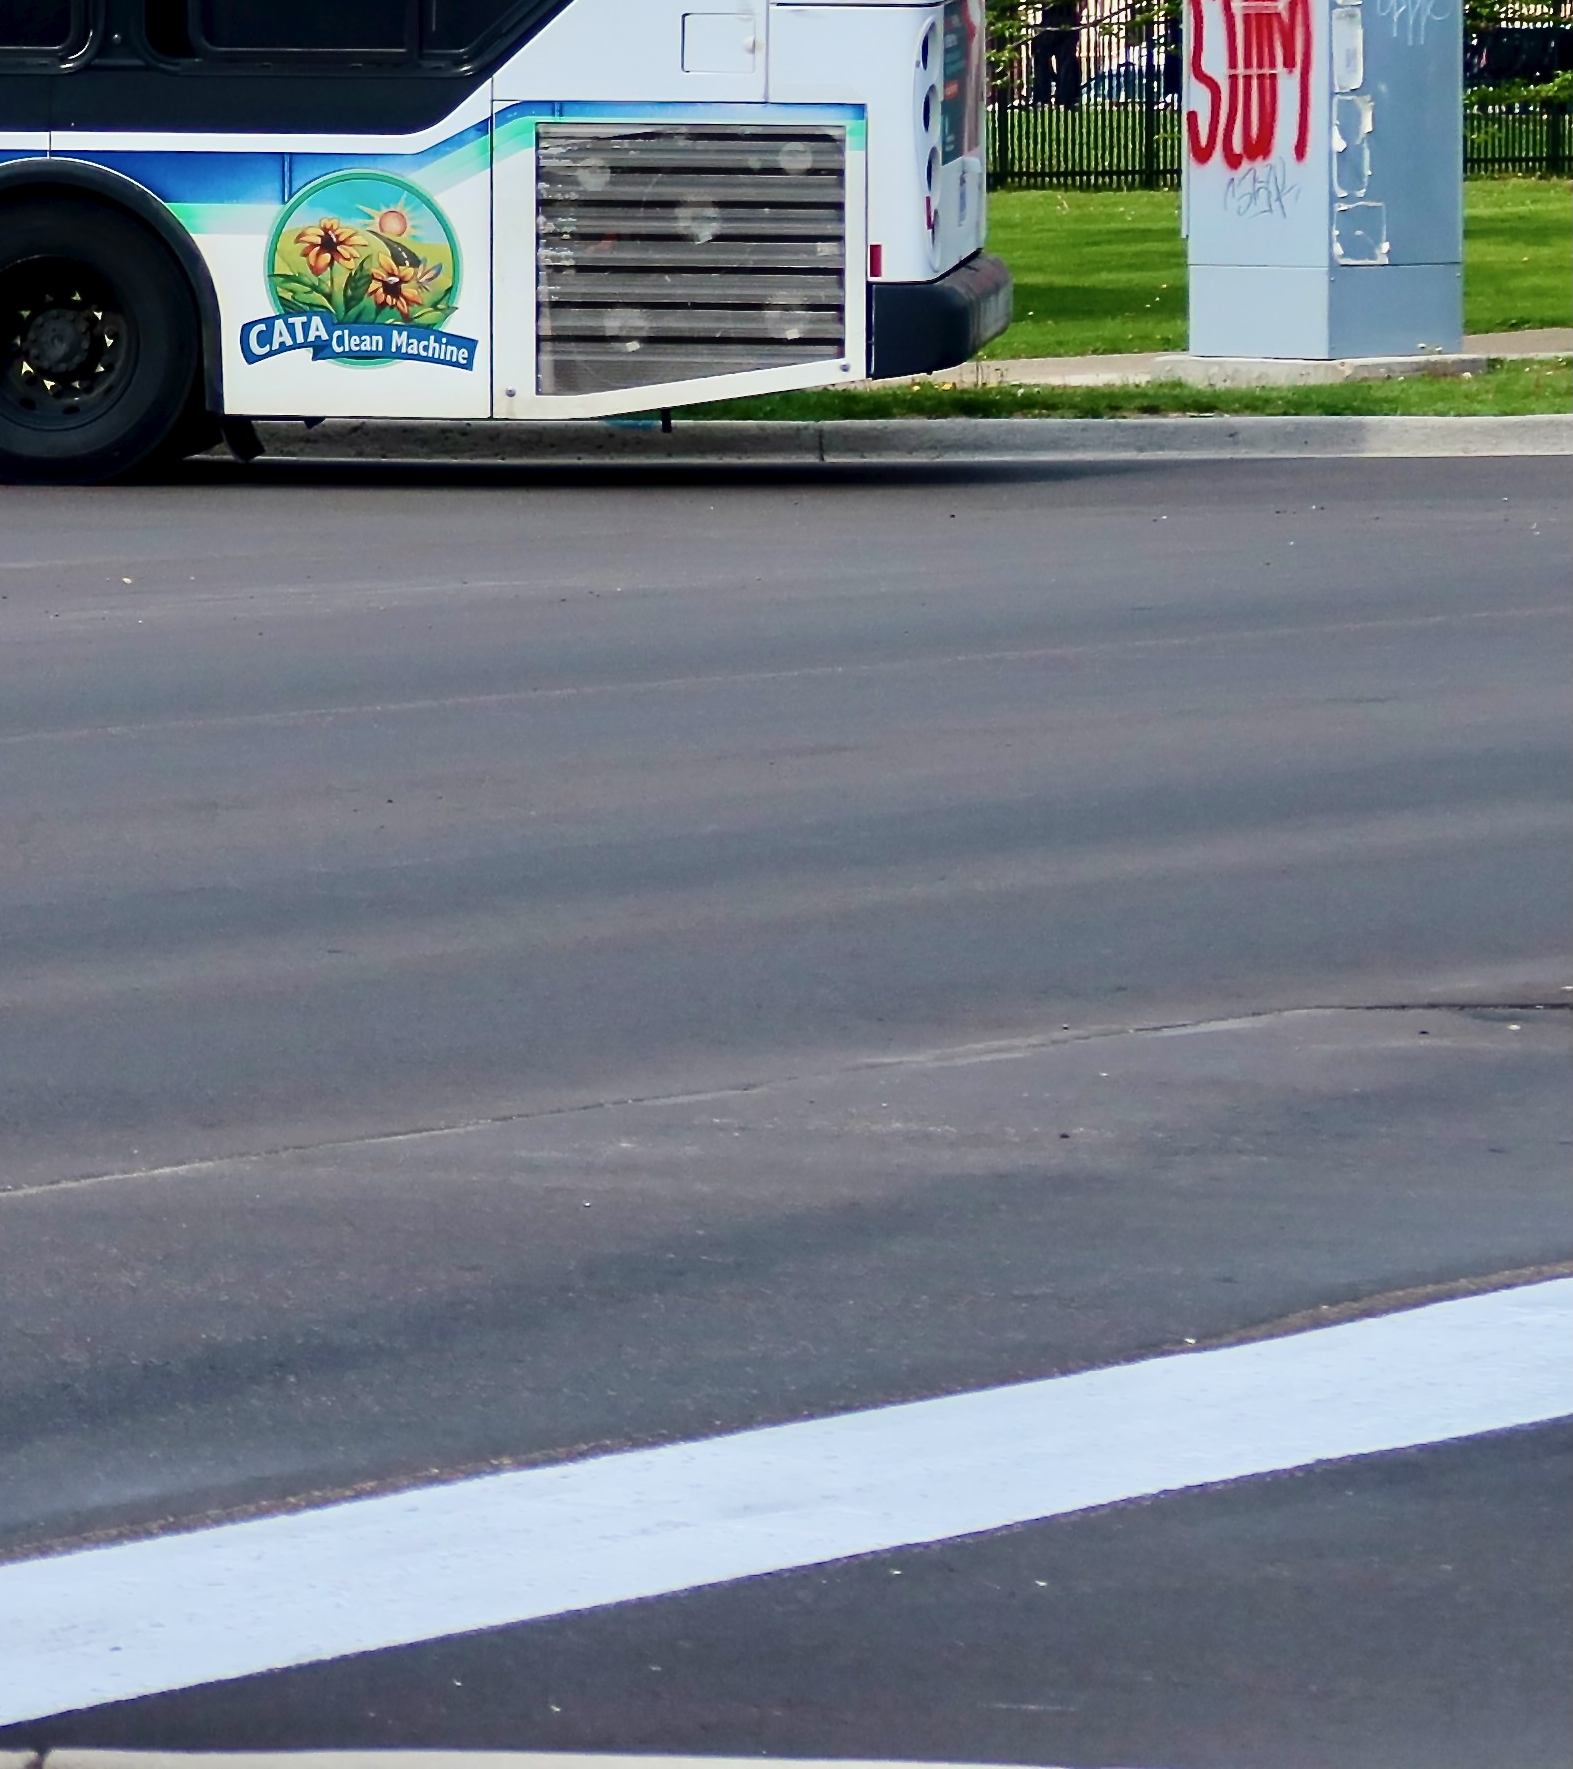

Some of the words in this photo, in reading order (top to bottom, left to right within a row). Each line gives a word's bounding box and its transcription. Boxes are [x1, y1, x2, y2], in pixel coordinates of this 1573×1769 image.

[247, 315, 329, 356] CATA
[331, 329, 384, 353] Clean
[390, 330, 469, 365] Machine
